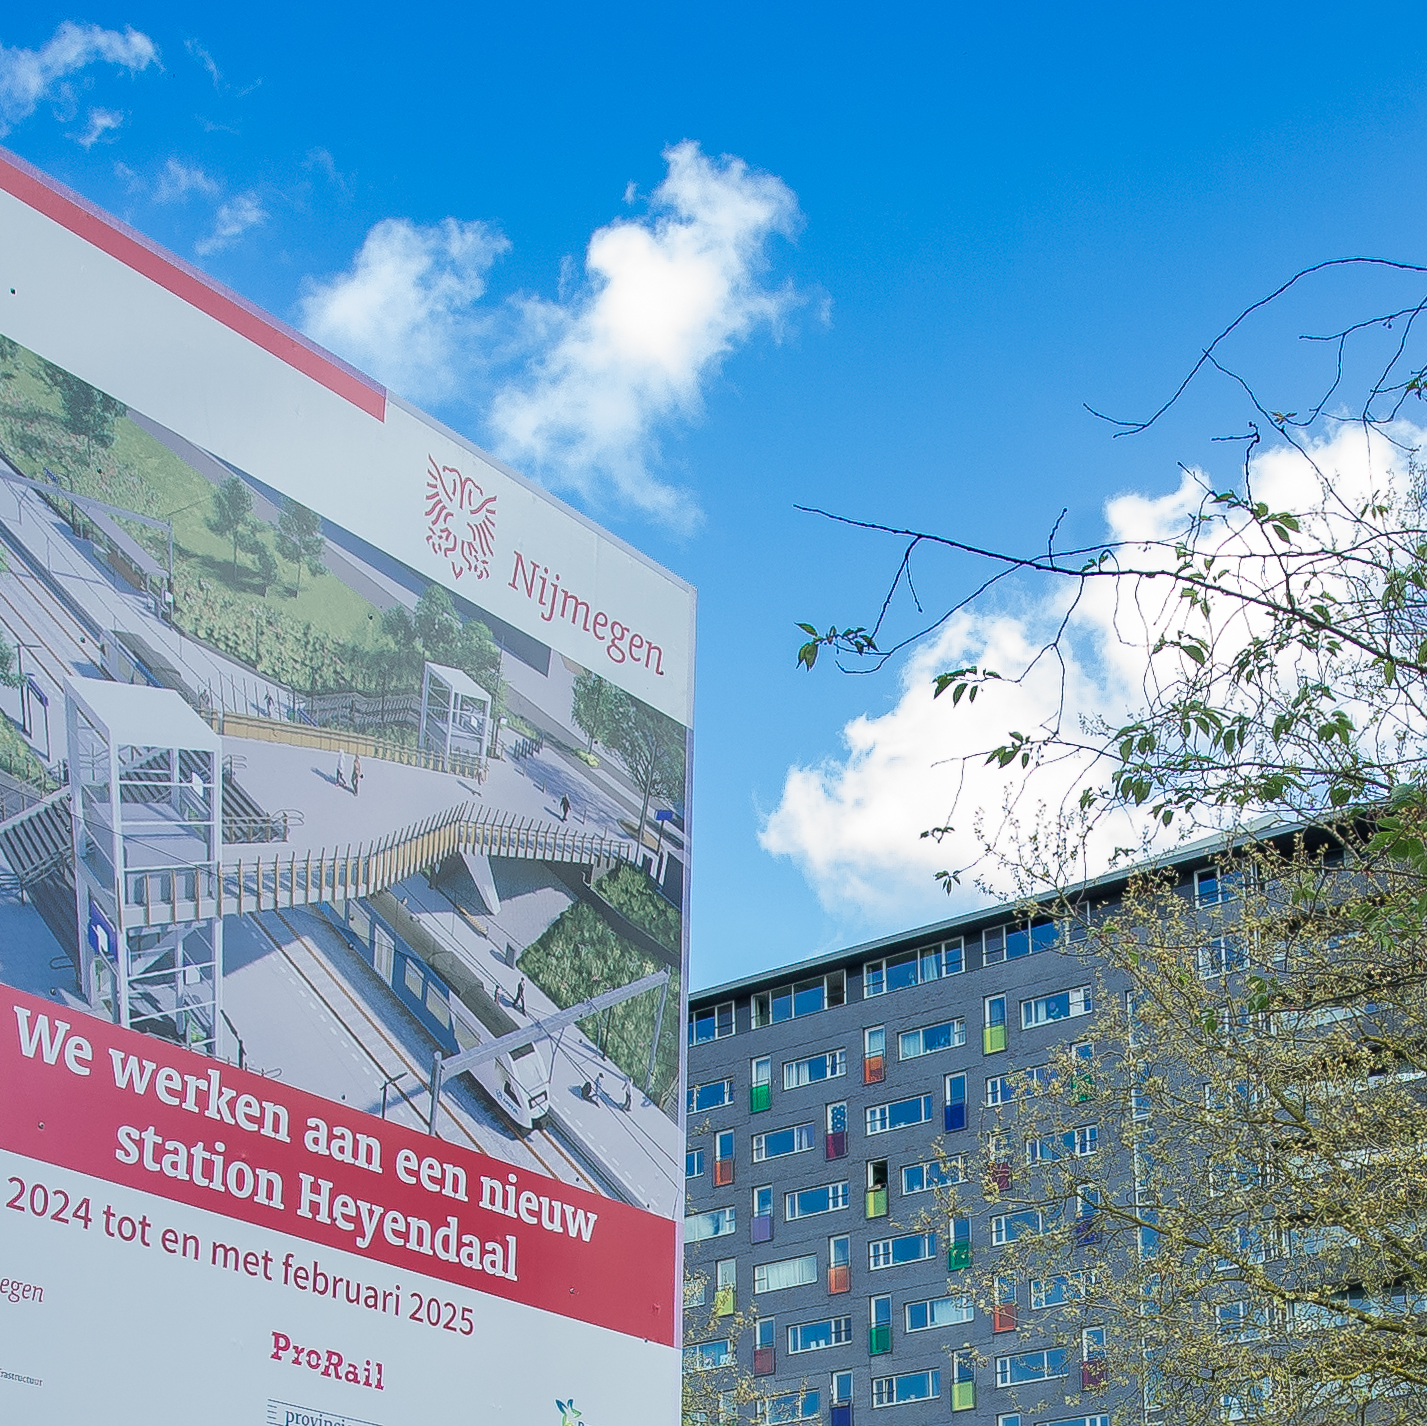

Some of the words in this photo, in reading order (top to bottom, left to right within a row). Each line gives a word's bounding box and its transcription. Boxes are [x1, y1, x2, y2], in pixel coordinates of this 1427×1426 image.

[507, 550, 665, 676] Nijmegen
[13, 1005, 94, 1076] We
[108, 1047, 292, 1144] werken
[303, 1116, 383, 1174] aan
[395, 1148, 469, 1202] een
[478, 1173, 599, 1243] nieuw
[115, 1124, 285, 1210] station
[296, 1172, 518, 1282] Heyendaal
[5, 1176, 93, 1230] 2024
[102, 1204, 152, 1247] tot
[161, 1227, 200, 1261] en
[211, 1241, 274, 1282] met
[282, 1253, 401, 1316] februari
[408, 1292, 474, 1336] 2025
[270, 1331, 385, 1391] ProRail
